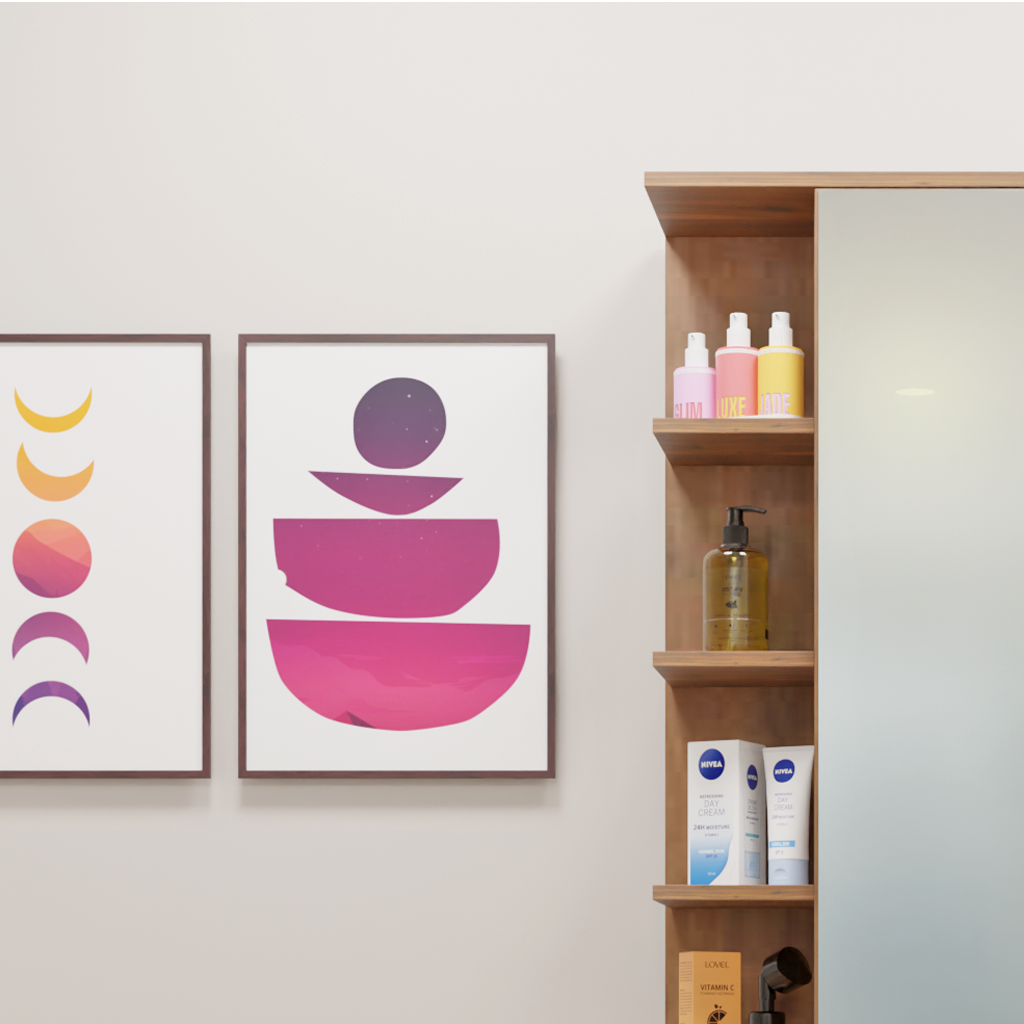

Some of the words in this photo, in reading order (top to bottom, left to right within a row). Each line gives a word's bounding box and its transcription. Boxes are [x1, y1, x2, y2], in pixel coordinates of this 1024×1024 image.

[716, 396, 746, 418] LUXE
[759, 392, 790, 415] JADE
[701, 760, 723, 768] NIVEA
[704, 800, 720, 808] DAY
[698, 808, 725, 817] CREAM
